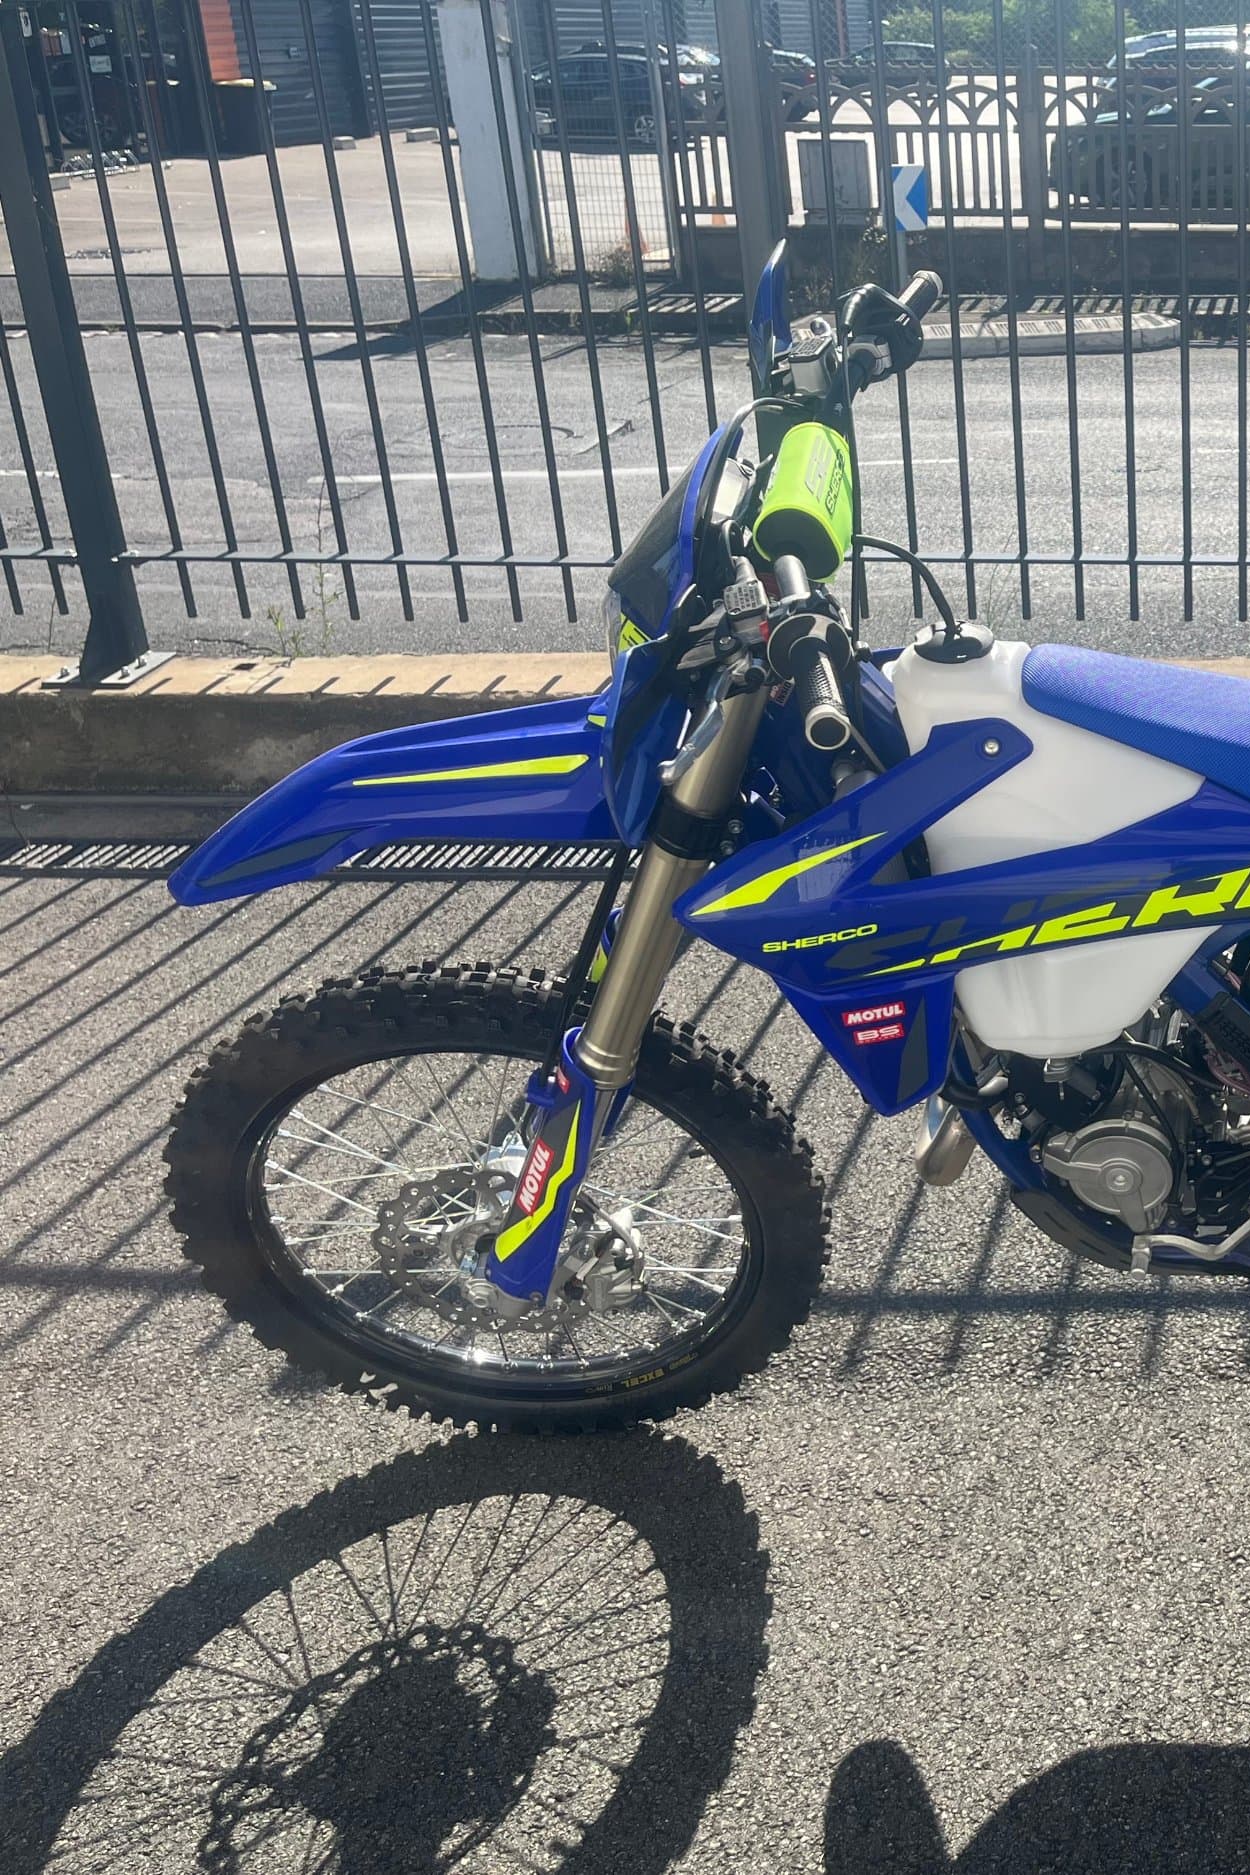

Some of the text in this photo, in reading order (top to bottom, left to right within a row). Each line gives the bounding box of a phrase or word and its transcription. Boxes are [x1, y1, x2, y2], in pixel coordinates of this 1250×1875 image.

[762, 923, 878, 953] SHERCO
[847, 1003, 904, 1026] MOTUL
[857, 1024, 900, 1041] BS
[519, 1143, 551, 1213] MOTUL
